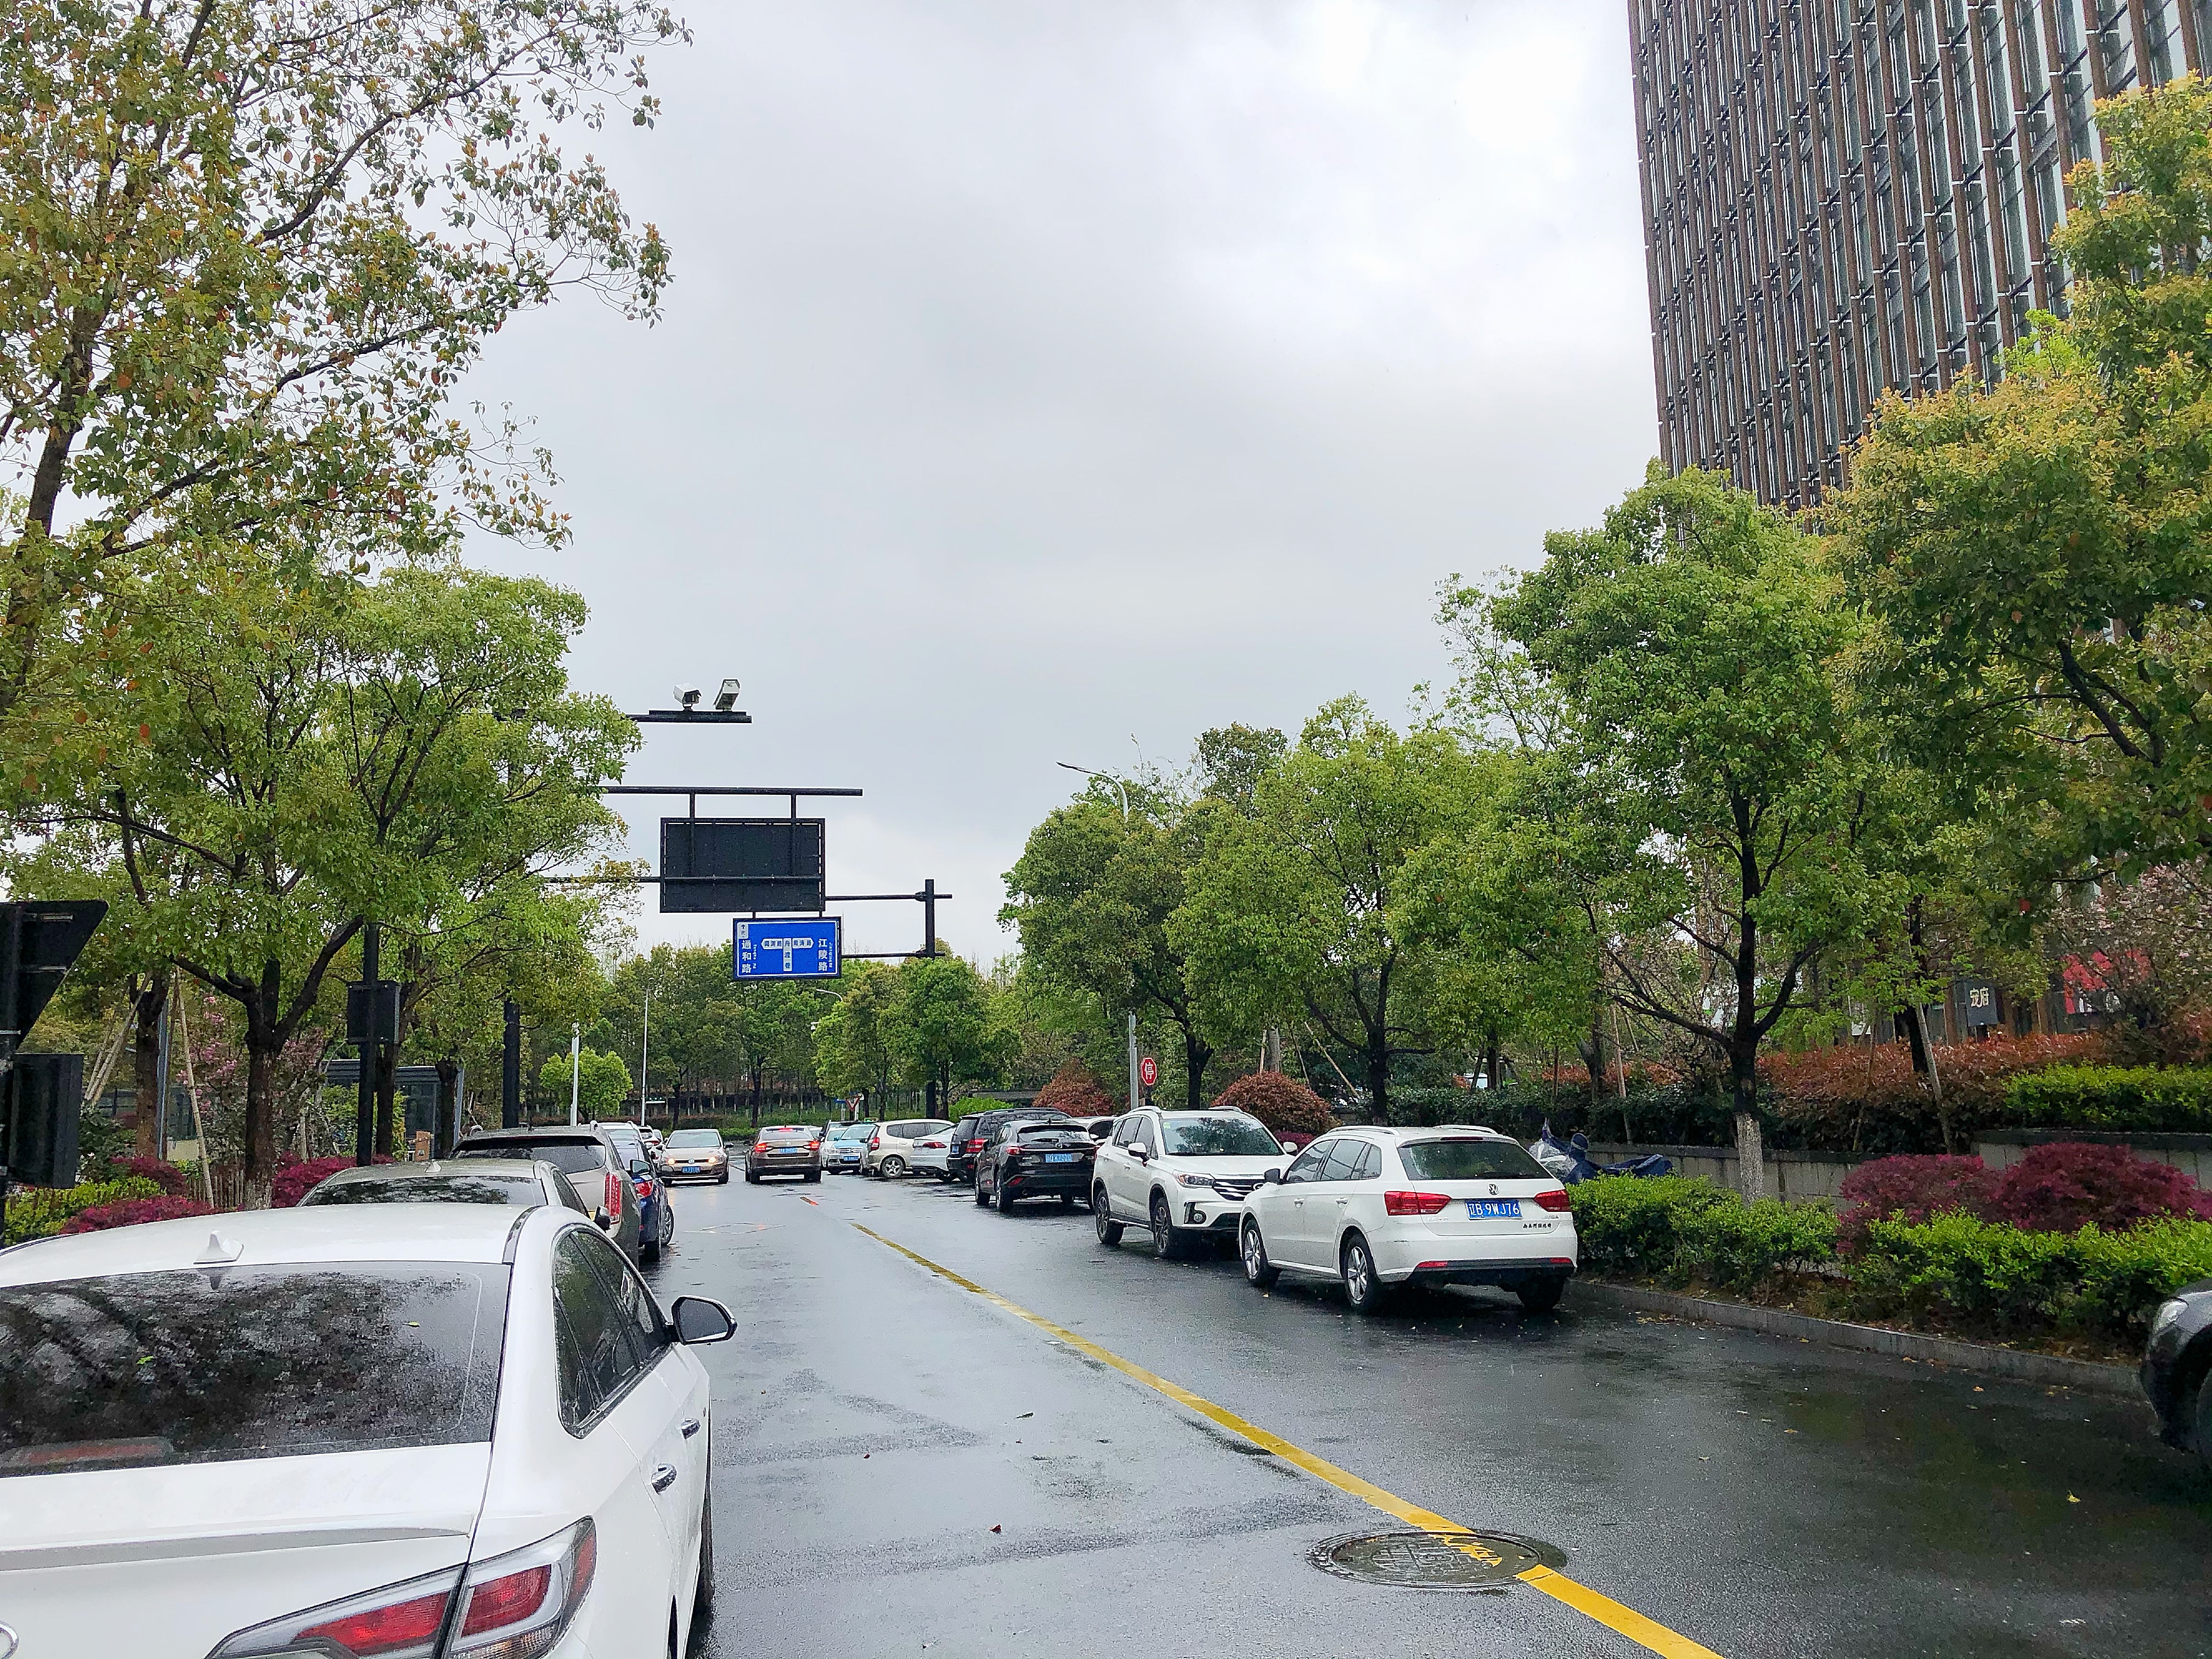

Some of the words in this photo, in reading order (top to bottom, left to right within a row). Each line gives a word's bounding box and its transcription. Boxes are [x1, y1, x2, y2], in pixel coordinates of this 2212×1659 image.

[742, 940, 752, 974] 通和路
[819, 939, 827, 971] 江陵路
[1970, 986, 1989, 1008] 宠府
[1144, 1062, 1154, 1080] 停
